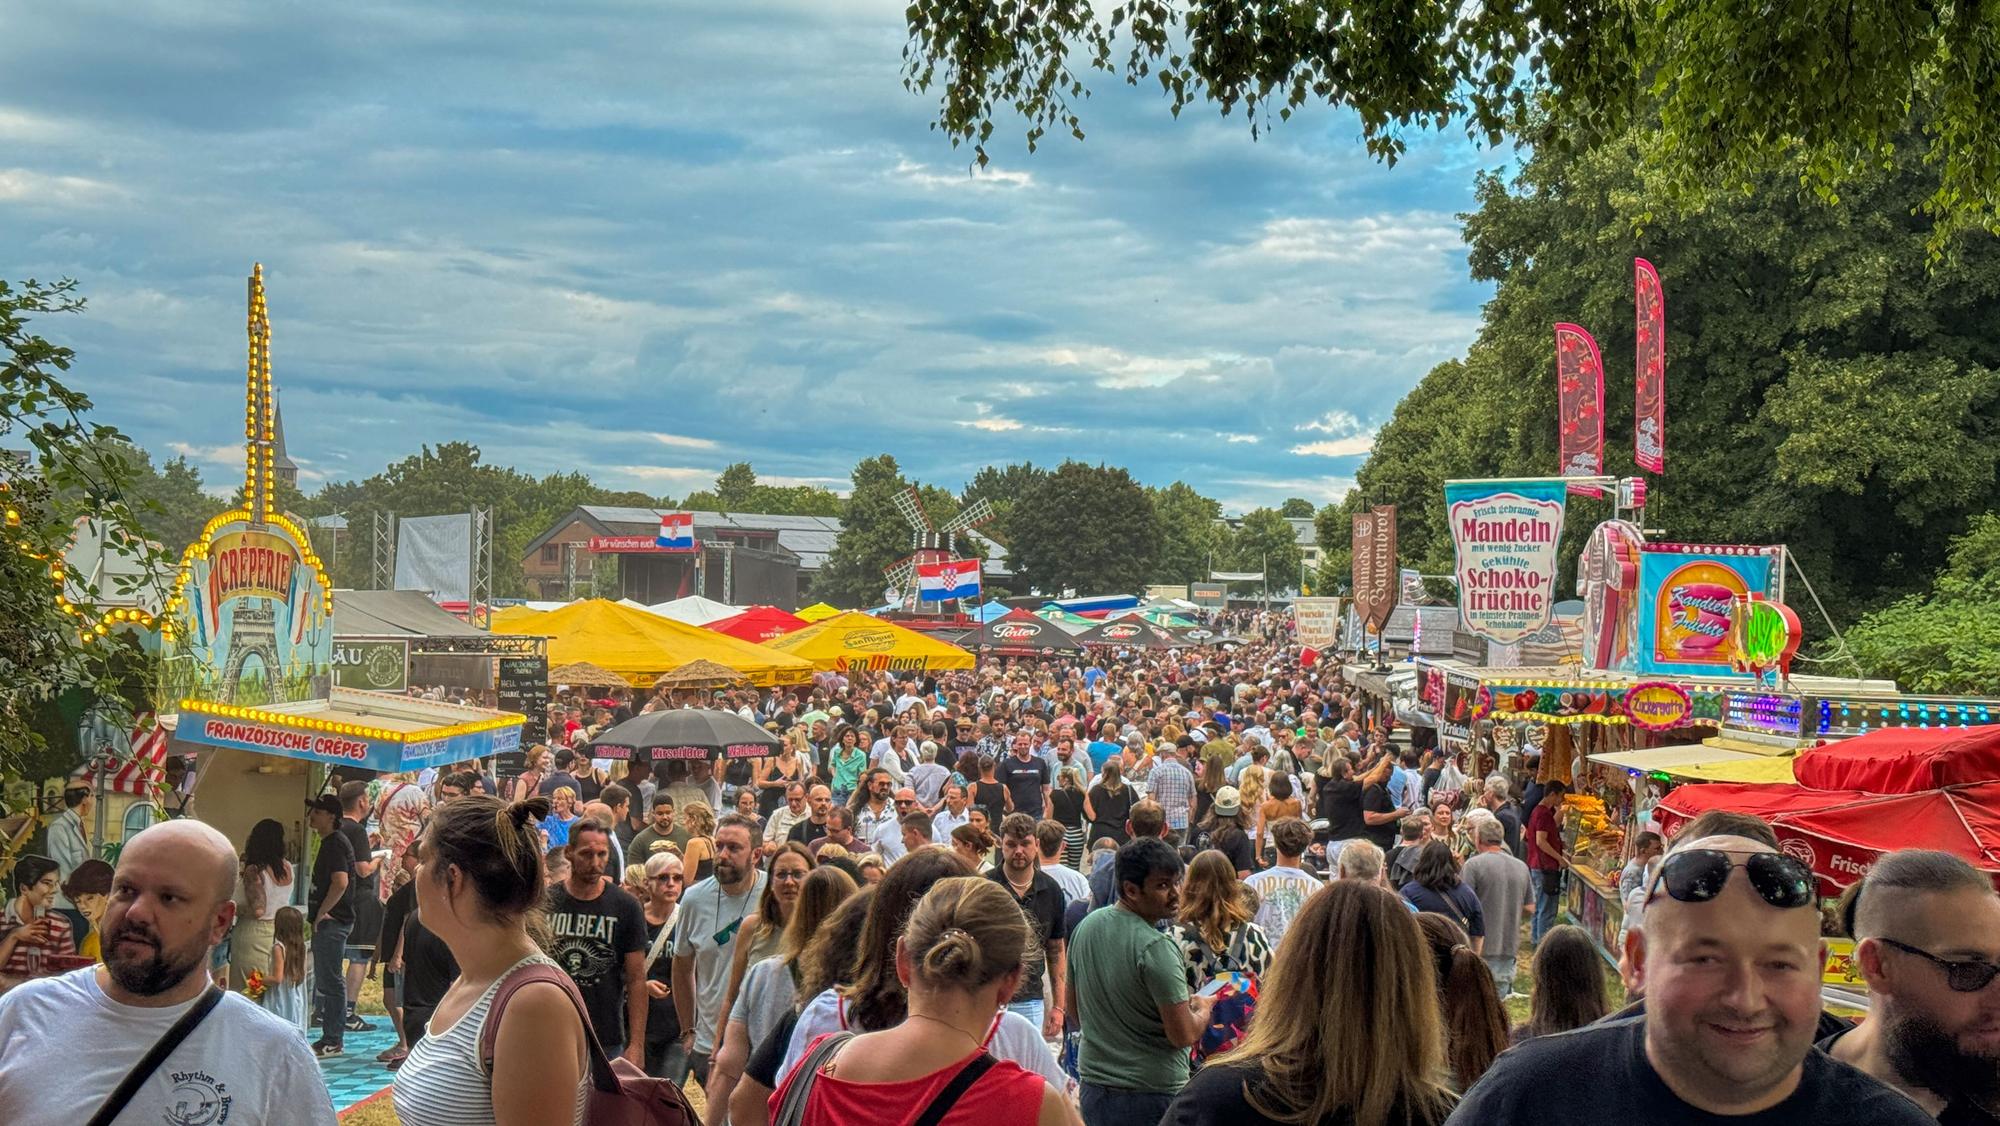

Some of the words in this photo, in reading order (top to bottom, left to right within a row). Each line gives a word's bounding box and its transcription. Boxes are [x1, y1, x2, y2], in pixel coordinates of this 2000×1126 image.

[1473, 505, 1497, 517] Frisch
[1499, 505, 1540, 518] gebrannte
[1462, 518, 1551, 543] Mandeln
[1369, 511, 1389, 606] Bauernbrot
[1471, 544, 1486, 553] mit
[1487, 544, 1512, 554] wenig
[1513, 543, 1542, 553] Zucker
[1481, 555, 1531, 569] Gekühlte
[1467, 567, 1549, 590] Schoko-
[1470, 590, 1543, 612] früchte
[1470, 611, 1478, 620] in
[1480, 611, 1506, 620] feinster
[1485, 620, 1528, 629] Schokolade
[993, 625, 1037, 639] Porter
[329, 644, 363, 665] ÄU
[205, 721, 312, 751] FRANZÖSISCHE
[314, 736, 368, 759] CRÊPES
[171, 1070, 215, 1084] Rhythm
[215, 1083, 226, 1094] &
